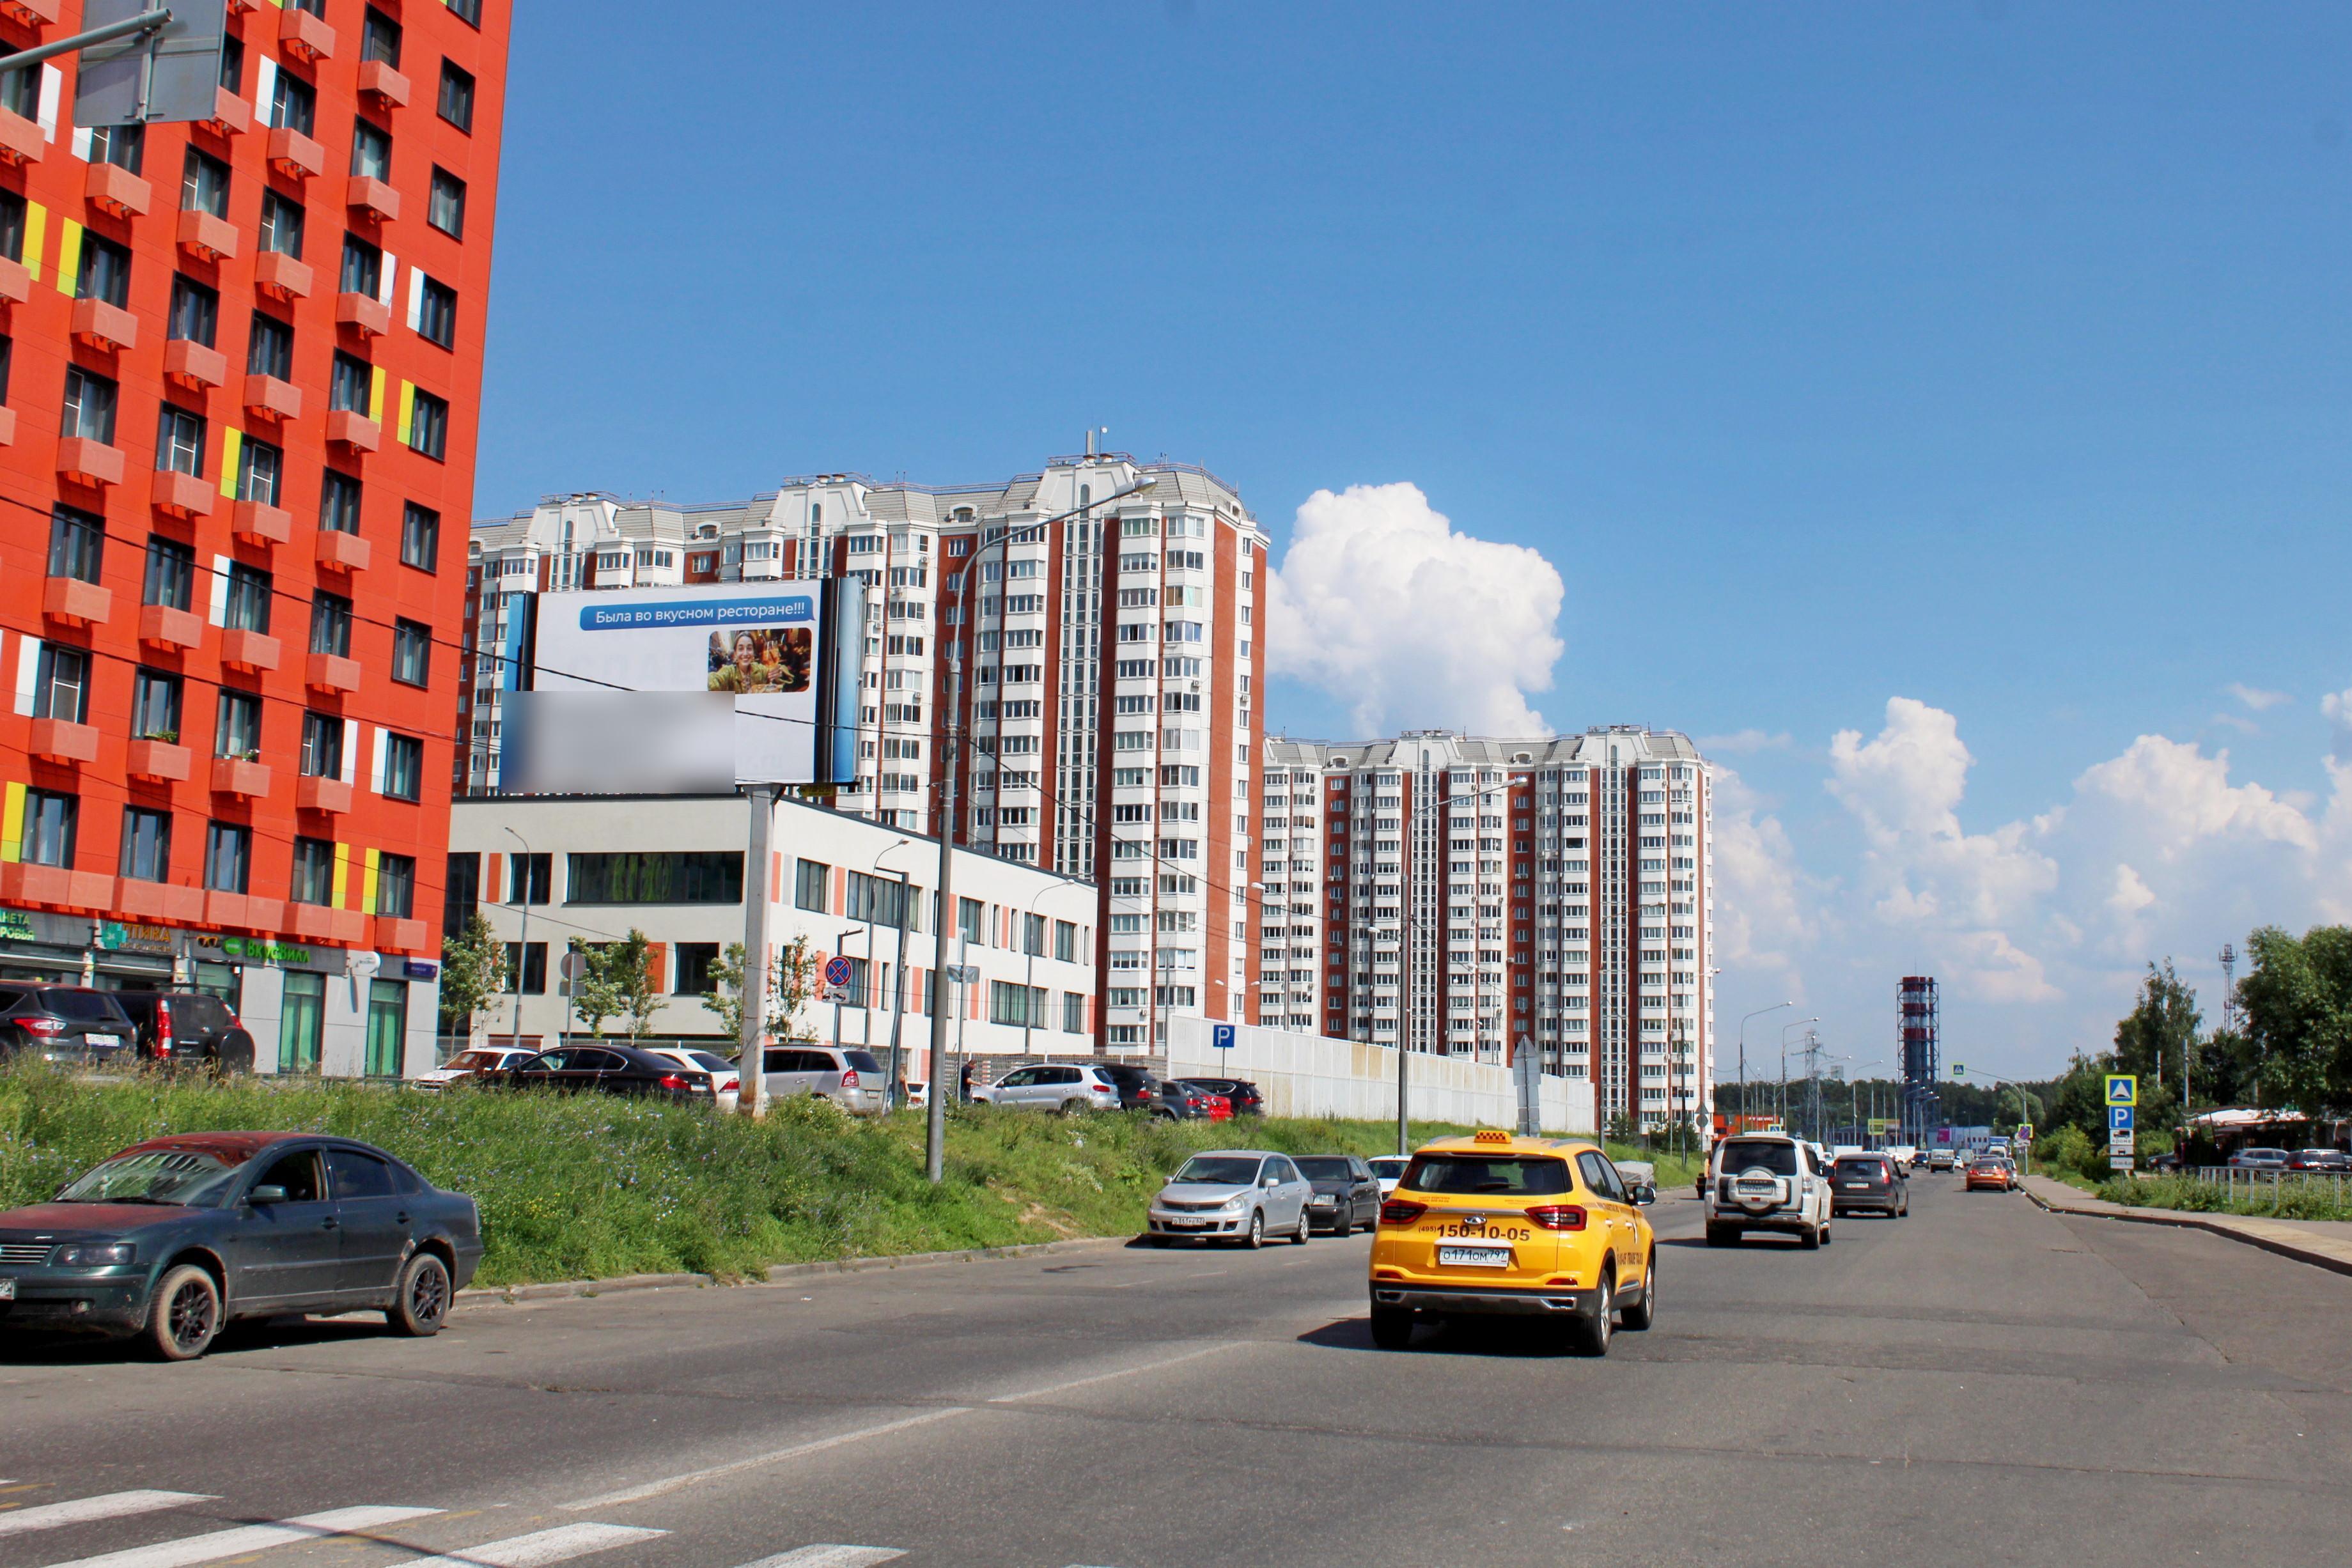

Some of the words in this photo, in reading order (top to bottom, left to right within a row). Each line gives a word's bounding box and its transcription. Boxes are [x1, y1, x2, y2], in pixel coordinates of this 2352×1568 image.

[595, 610, 632, 624] Была
[635, 611, 651, 622] во
[655, 608, 713, 623] вкусном
[717, 602, 805, 620] ресторане!!!
[0, 908, 31, 925] НЕТА
[123, 923, 172, 943] ПТИКА
[1218, 1027, 1231, 1045] P
[2115, 1108, 2128, 1126] P
